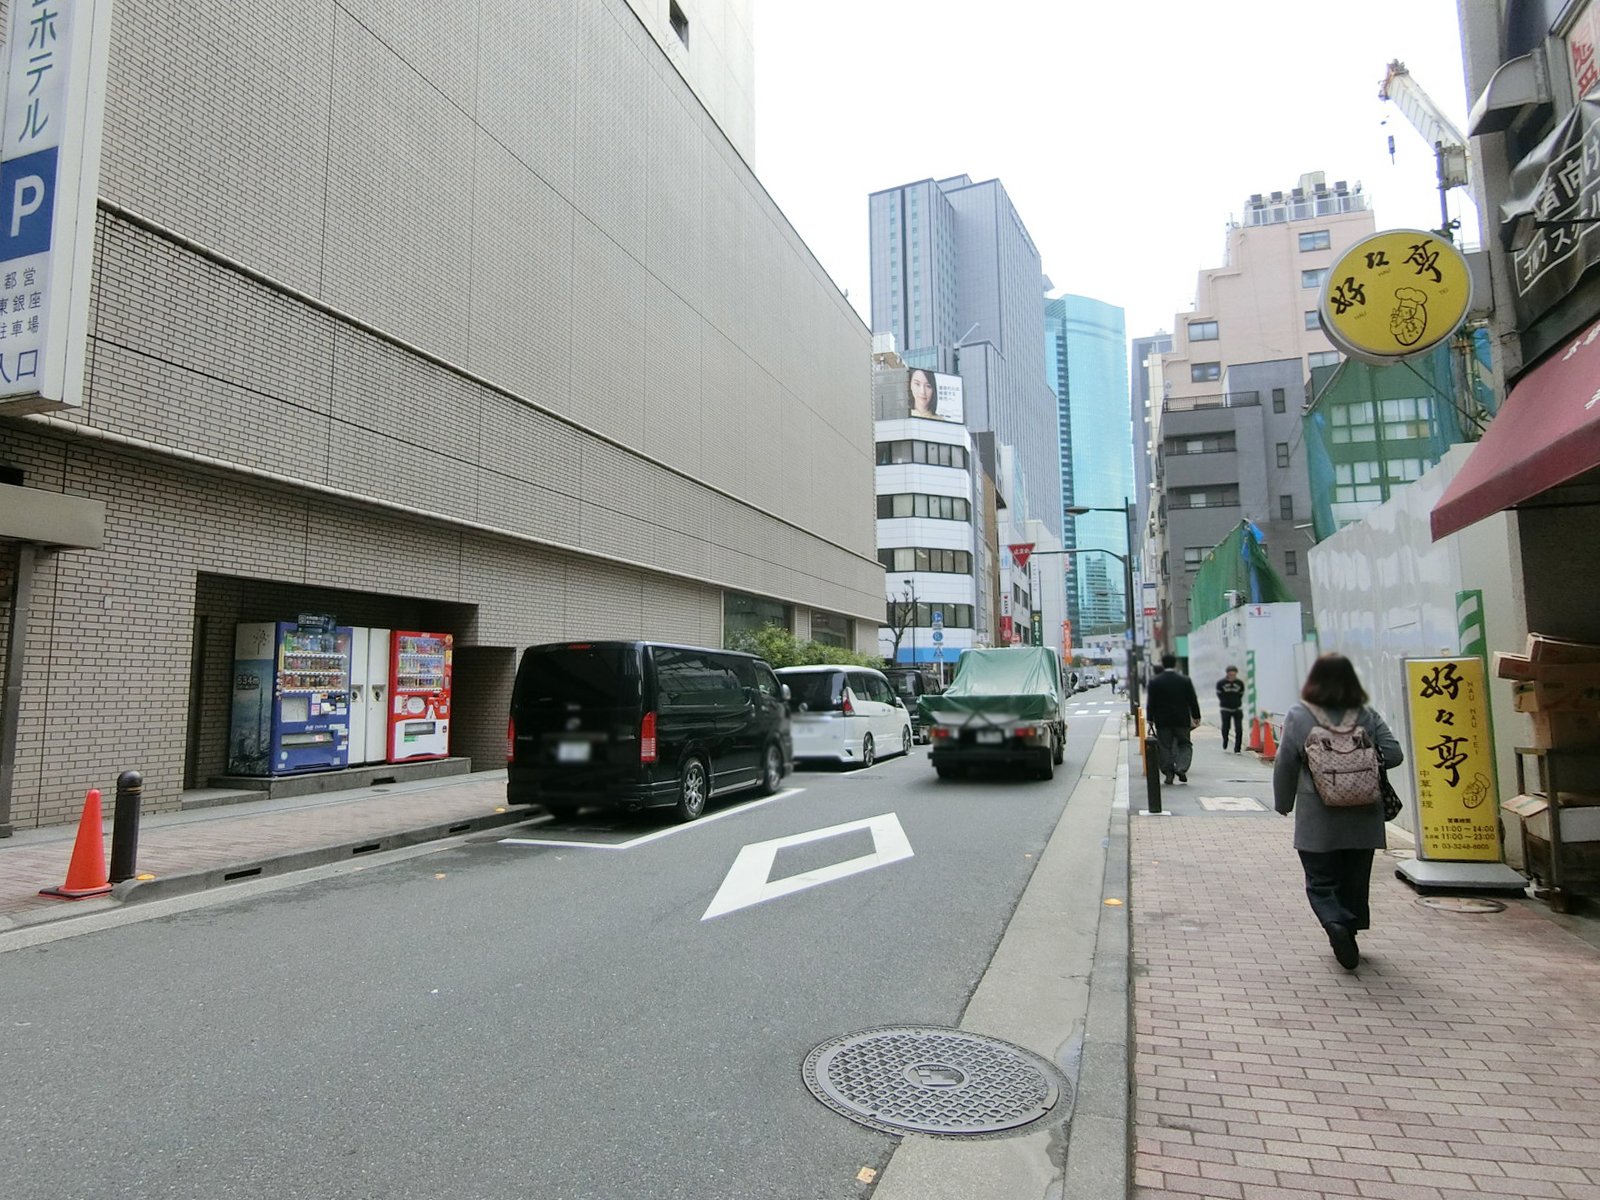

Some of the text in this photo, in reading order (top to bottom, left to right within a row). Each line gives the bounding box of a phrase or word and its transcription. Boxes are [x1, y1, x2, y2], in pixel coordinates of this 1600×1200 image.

[18, 0, 59, 142] ホテル
[10, 174, 46, 238] P
[4, 266, 36, 290] 都営
[1255, 606, 1261, 615] 1
[1466, 681, 1475, 701] HAU
[1419, 663, 1469, 788] 好々亭
[1419, 770, 1434, 809] 中華料理
